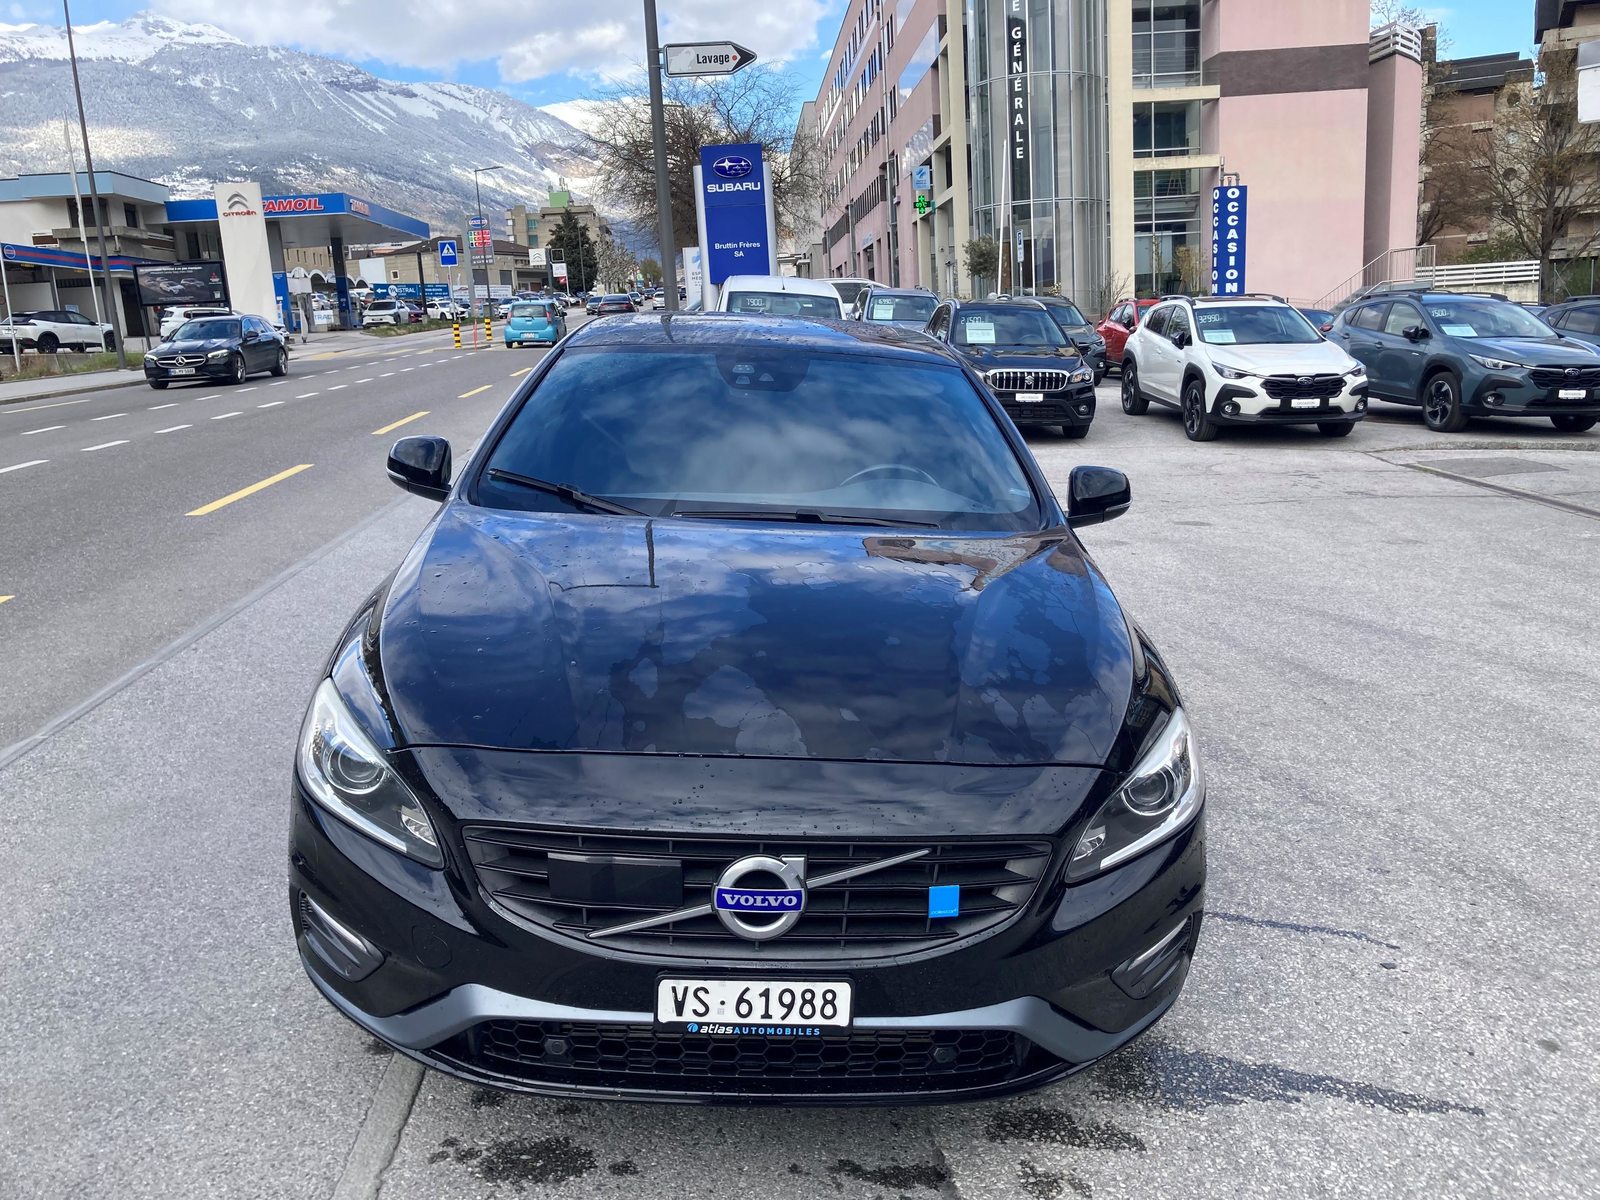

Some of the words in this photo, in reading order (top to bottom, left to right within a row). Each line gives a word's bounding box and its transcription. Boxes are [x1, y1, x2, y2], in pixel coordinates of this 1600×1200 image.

[696, 53, 730, 65] Lavage
[1011, 27, 1024, 159] GÉNÉRALE
[707, 182, 761, 193] SUBARU
[739, 241, 761, 249] Frères
[1211, 189, 1220, 294] OCCASION
[1225, 187, 1240, 293] OCCASION
[722, 893, 798, 908] VOLVO
[671, 985, 710, 1018] VS
[735, 986, 838, 1021] 61988
